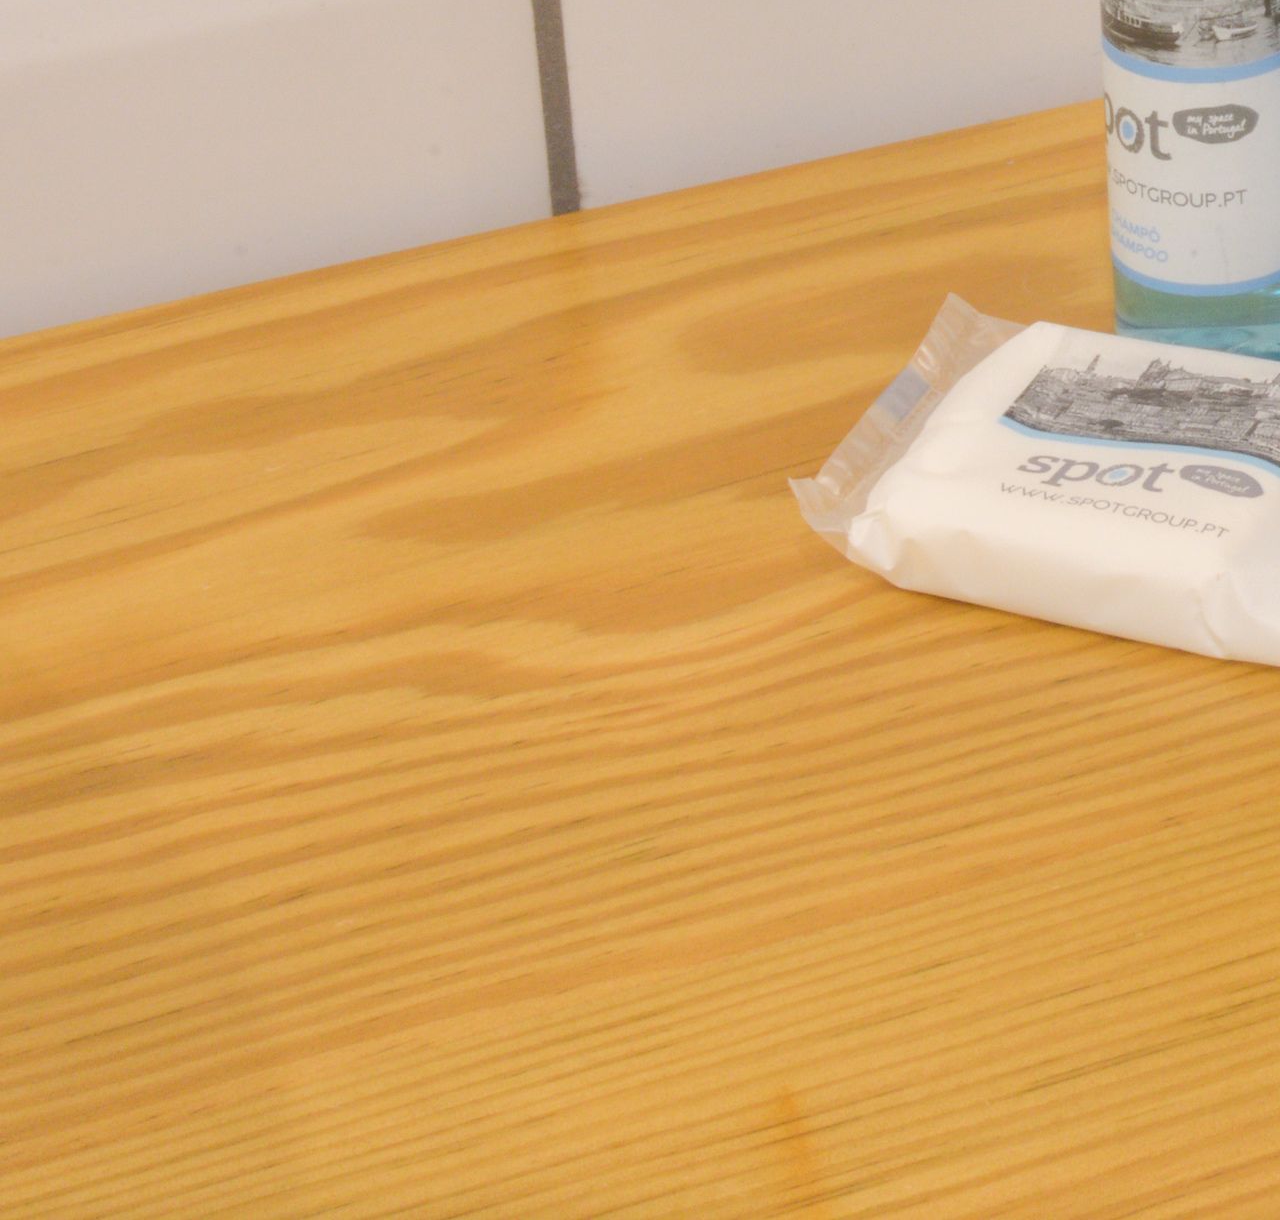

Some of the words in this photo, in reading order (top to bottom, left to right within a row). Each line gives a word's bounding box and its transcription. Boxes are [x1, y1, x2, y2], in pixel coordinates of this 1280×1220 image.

[1111, 167, 1248, 208] SPOTGROUP.PT
[1017, 454, 1174, 492] spot
[1000, 481, 1230, 539] WWW.SPOTGROUP.PT
